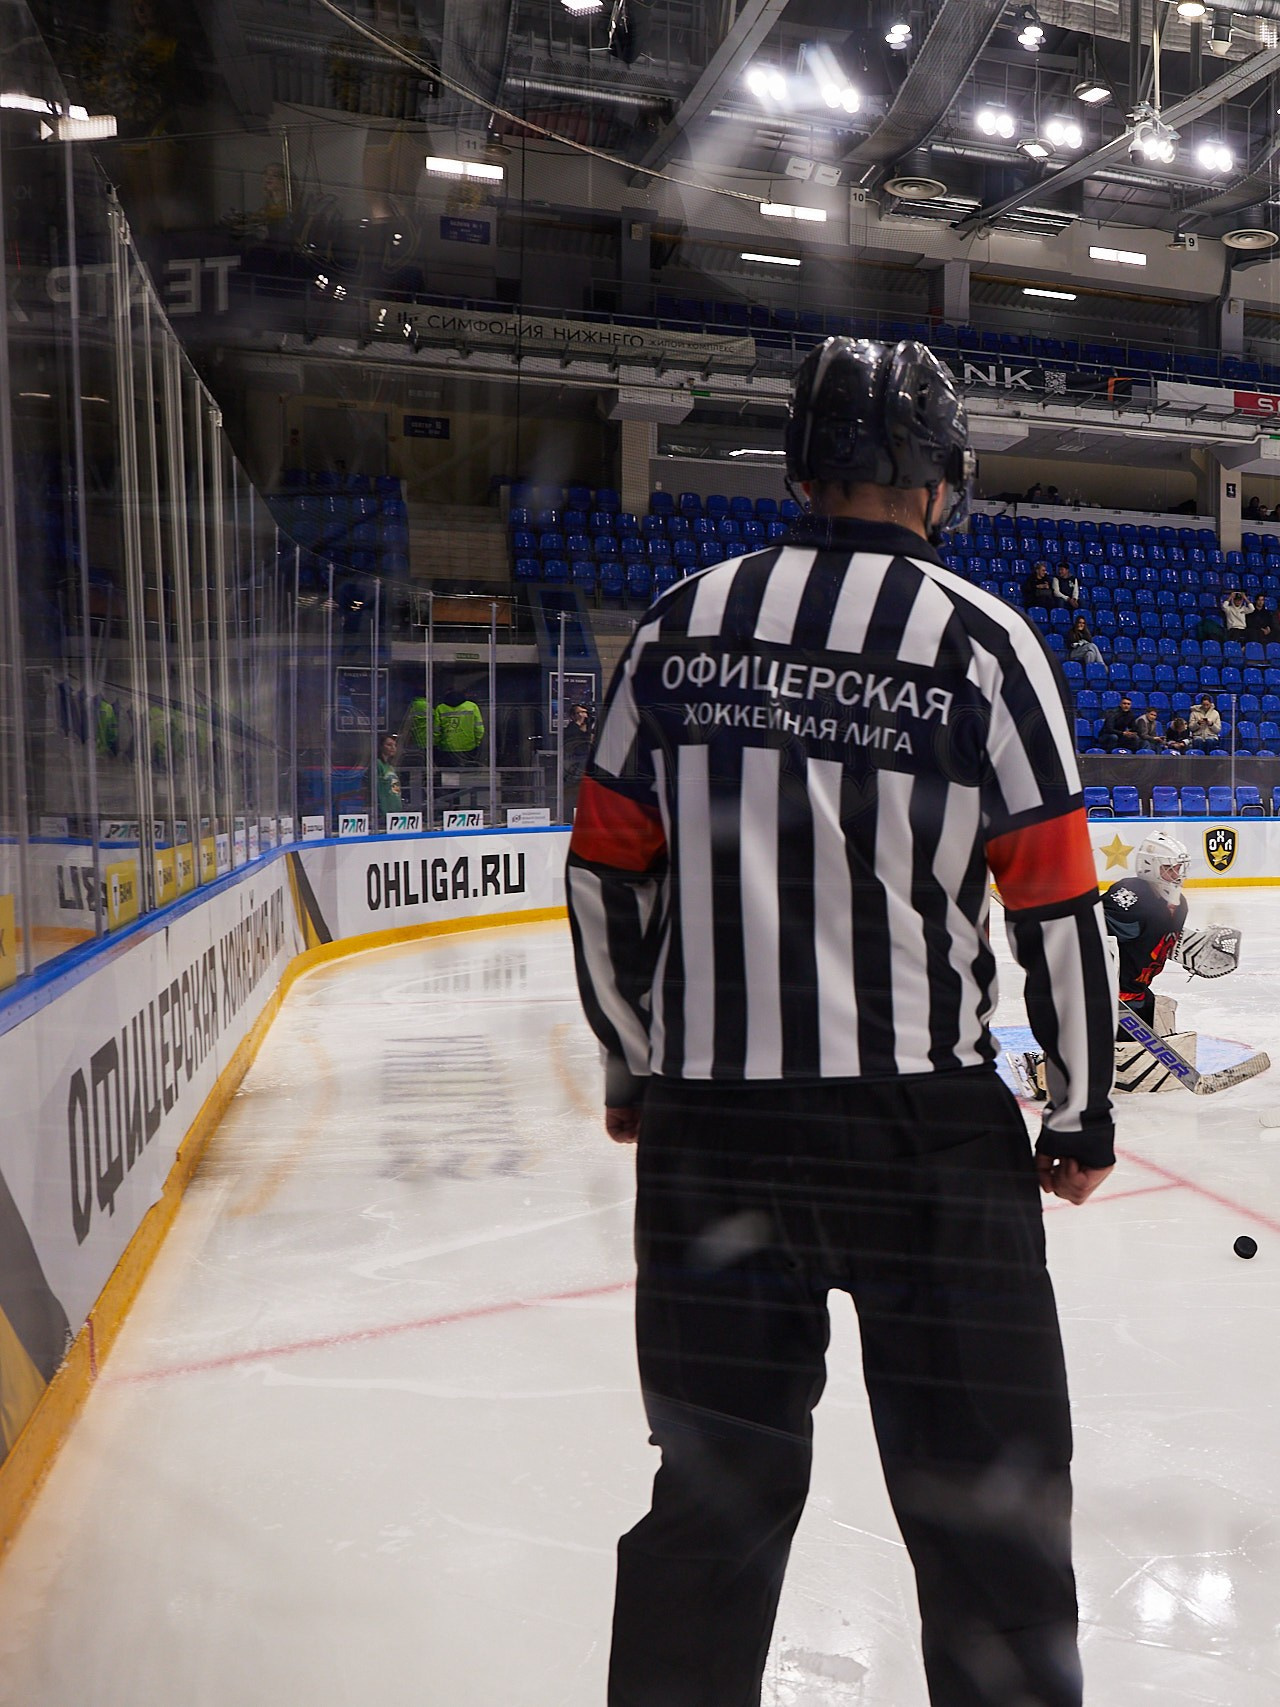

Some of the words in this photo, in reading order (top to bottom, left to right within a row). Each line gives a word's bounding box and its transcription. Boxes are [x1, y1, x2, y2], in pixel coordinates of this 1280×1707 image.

[853, 192, 864, 201] 10
[1188, 238, 1195, 247] 9
[427, 315, 543, 339] СИМФОНИЯ
[553, 328, 644, 348] НИЖНЕГО
[661, 652, 954, 726] ОФИЦЕРСКАЯ
[682, 702, 838, 742] ХОККЕЙНАЯ
[843, 721, 914, 755] ЛИГА
[1208, 830, 1233, 851] ОХЛ
[367, 852, 526, 911] OHLIGA.RU
[1119, 1015, 1190, 1079] BAUER
[68, 945, 220, 1247] ОФИЦЕРСКАЯ
